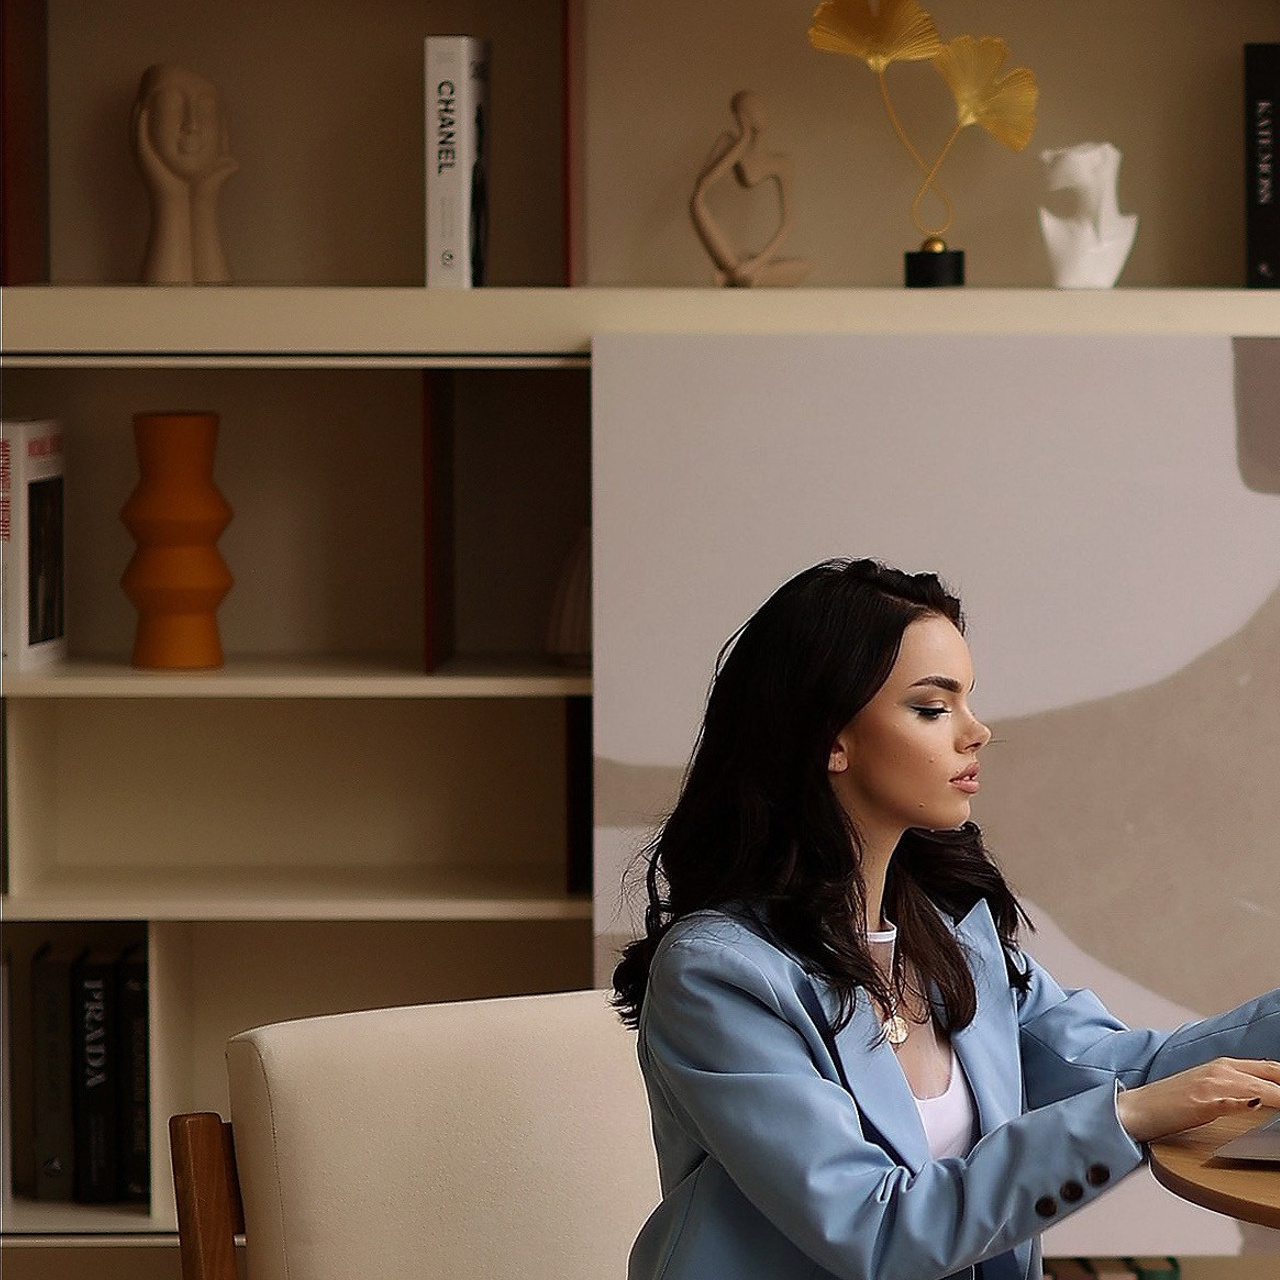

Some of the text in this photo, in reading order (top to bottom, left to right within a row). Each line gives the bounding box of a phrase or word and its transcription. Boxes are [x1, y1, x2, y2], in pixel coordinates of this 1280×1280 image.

[437, 79, 456, 176] CHANEL
[1256, 101, 1272, 204] KATE MOSS
[84, 979, 107, 1088] PRADA
